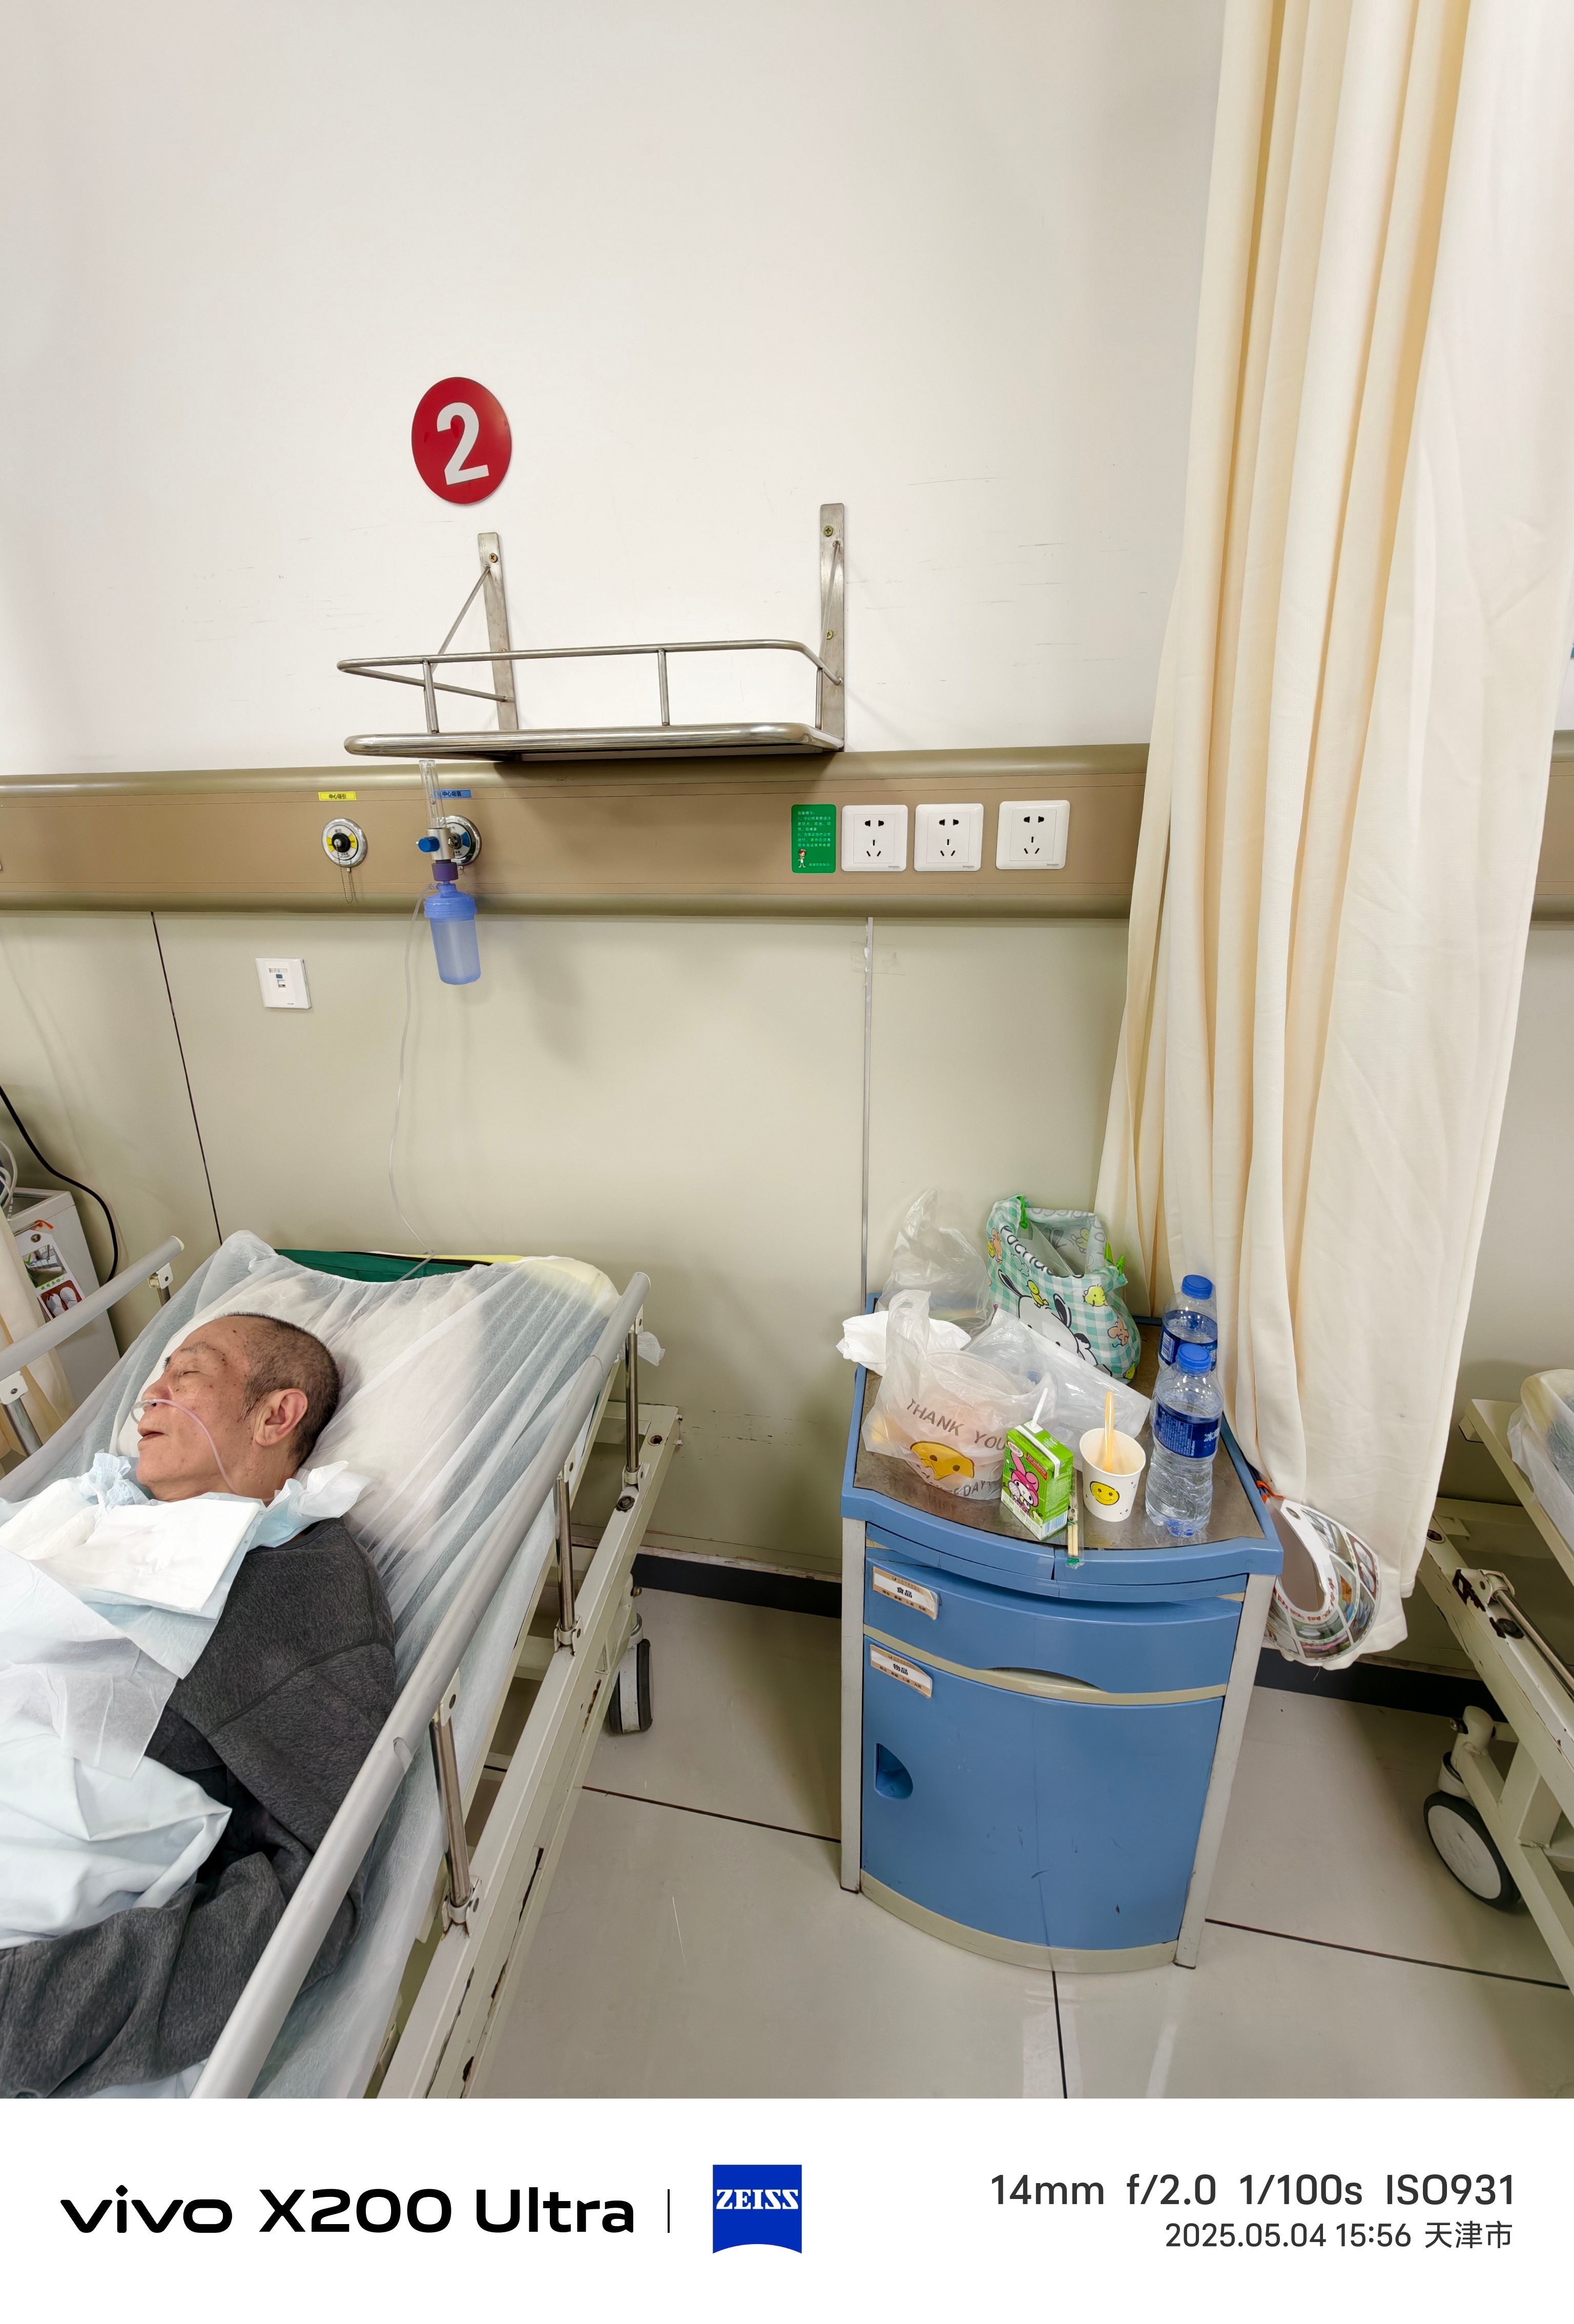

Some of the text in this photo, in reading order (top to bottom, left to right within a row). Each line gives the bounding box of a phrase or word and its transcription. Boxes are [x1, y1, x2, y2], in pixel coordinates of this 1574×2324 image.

[437, 402, 490, 485] 2
[906, 1397, 964, 1436] THANK
[974, 1430, 1006, 1451] YOU
[897, 1586, 913, 1598] 食品
[893, 1663, 909, 1675] 物品
